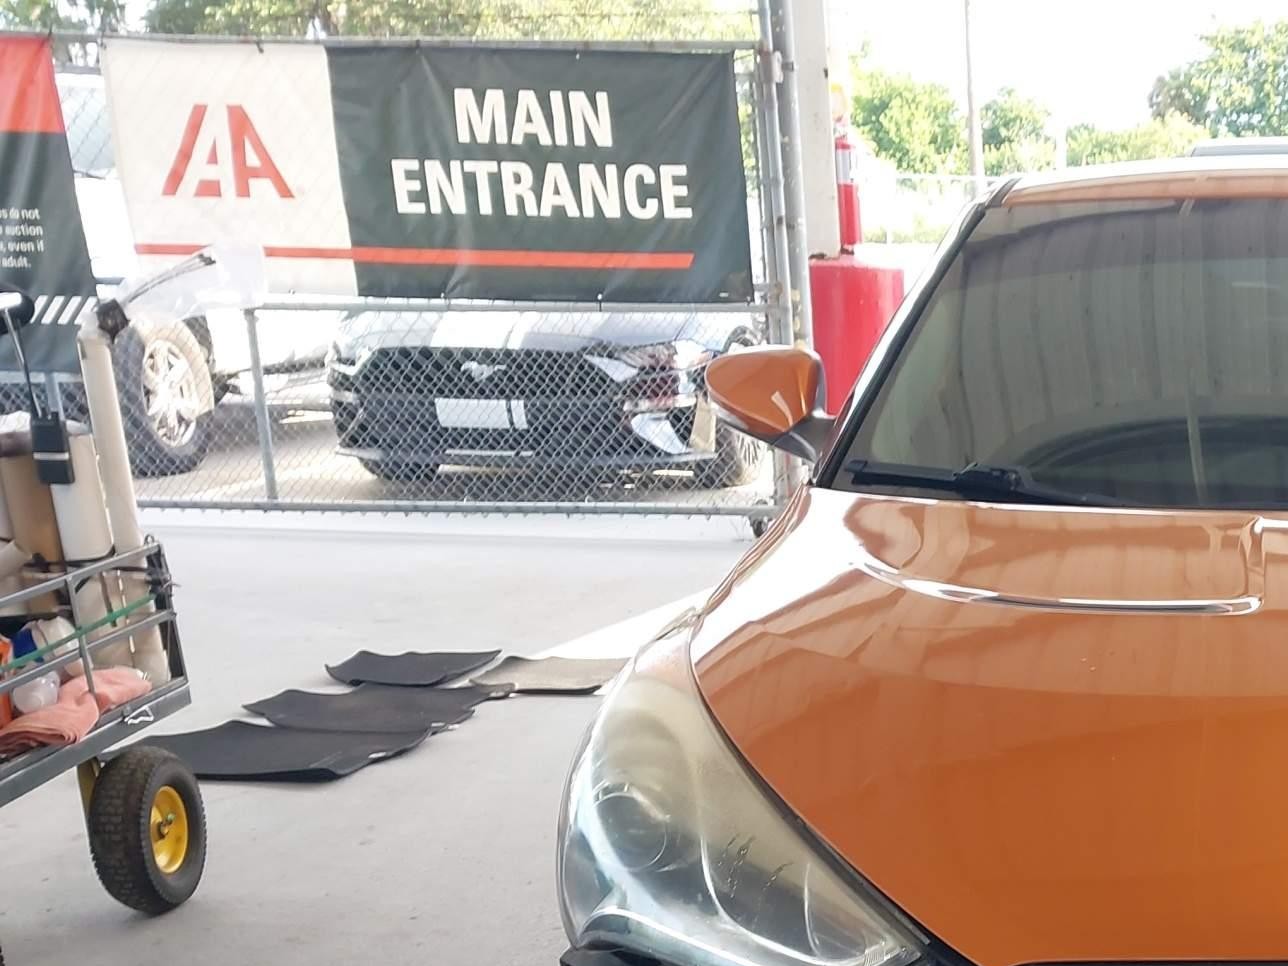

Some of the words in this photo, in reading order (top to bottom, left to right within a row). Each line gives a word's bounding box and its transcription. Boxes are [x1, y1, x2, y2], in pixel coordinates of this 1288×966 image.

[453, 87, 614, 148] MAIN
[161, 104, 296, 198] IAA
[390, 158, 694, 220] ENTRANCE
[21, 208, 41, 220] not
[5, 224, 44, 237] auction
[8, 241, 35, 253] even
[36, 239, 45, 253] if
[2, 255, 32, 269] adult.
